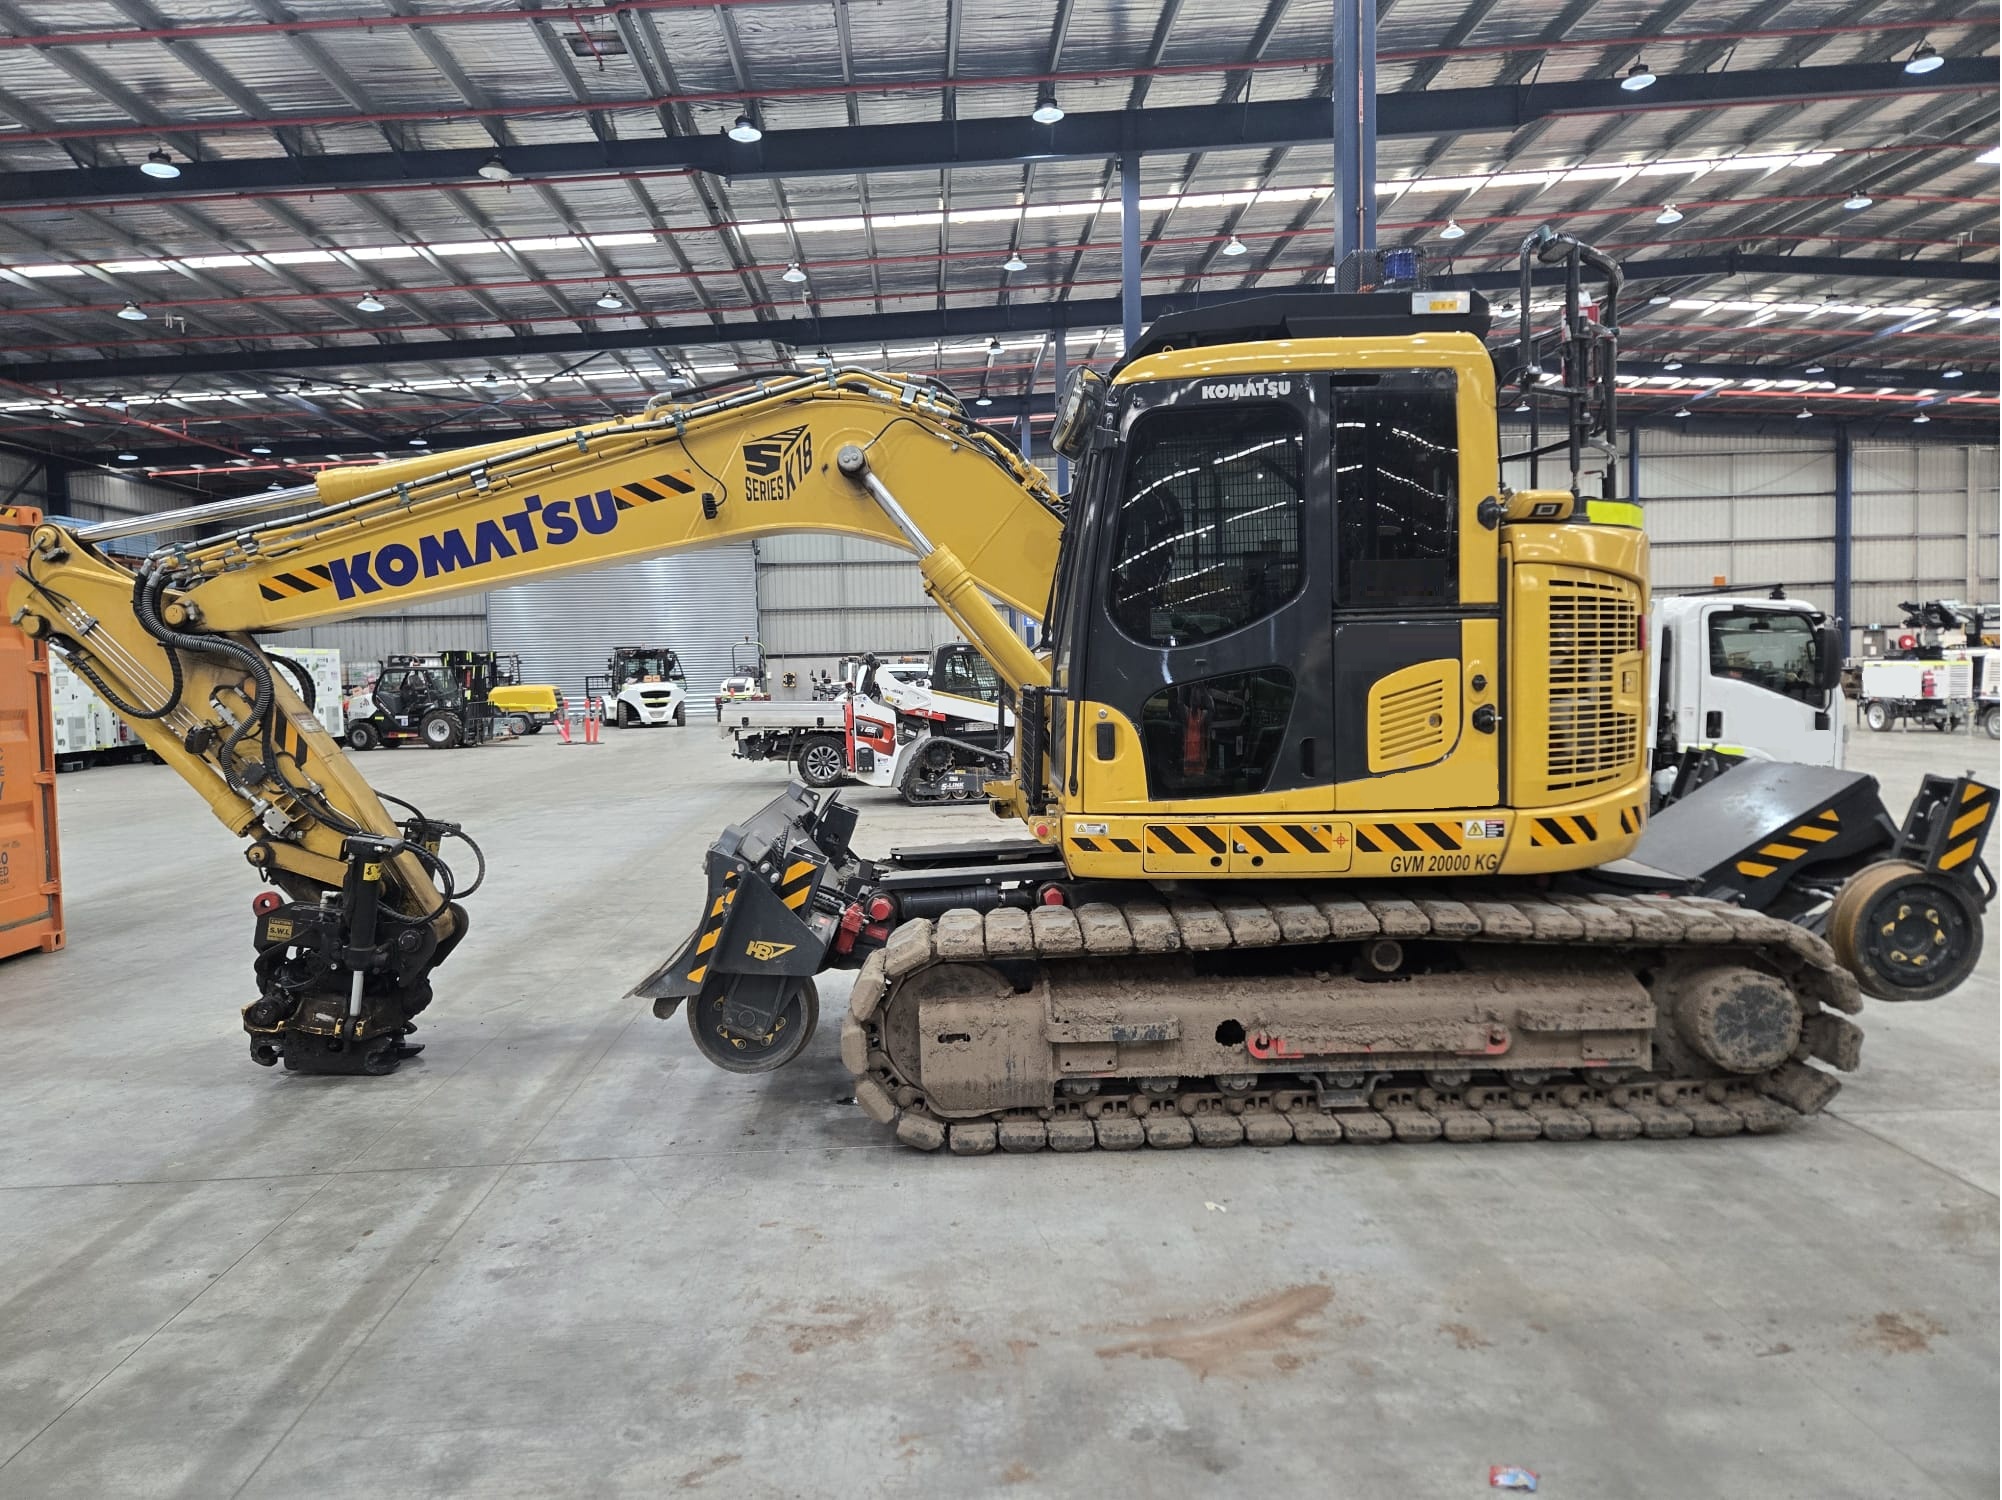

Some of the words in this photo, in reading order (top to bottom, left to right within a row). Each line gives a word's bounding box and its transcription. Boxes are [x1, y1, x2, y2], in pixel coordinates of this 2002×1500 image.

[1202, 378, 1291, 400] KOMATSU
[785, 432, 812, 500] K18
[745, 475, 784, 501] SERIES
[328, 489, 618, 600] KOMATSU
[1391, 855, 1424, 872] GVM
[1428, 855, 1471, 872] 20000
[1474, 854, 1497, 870] KG
